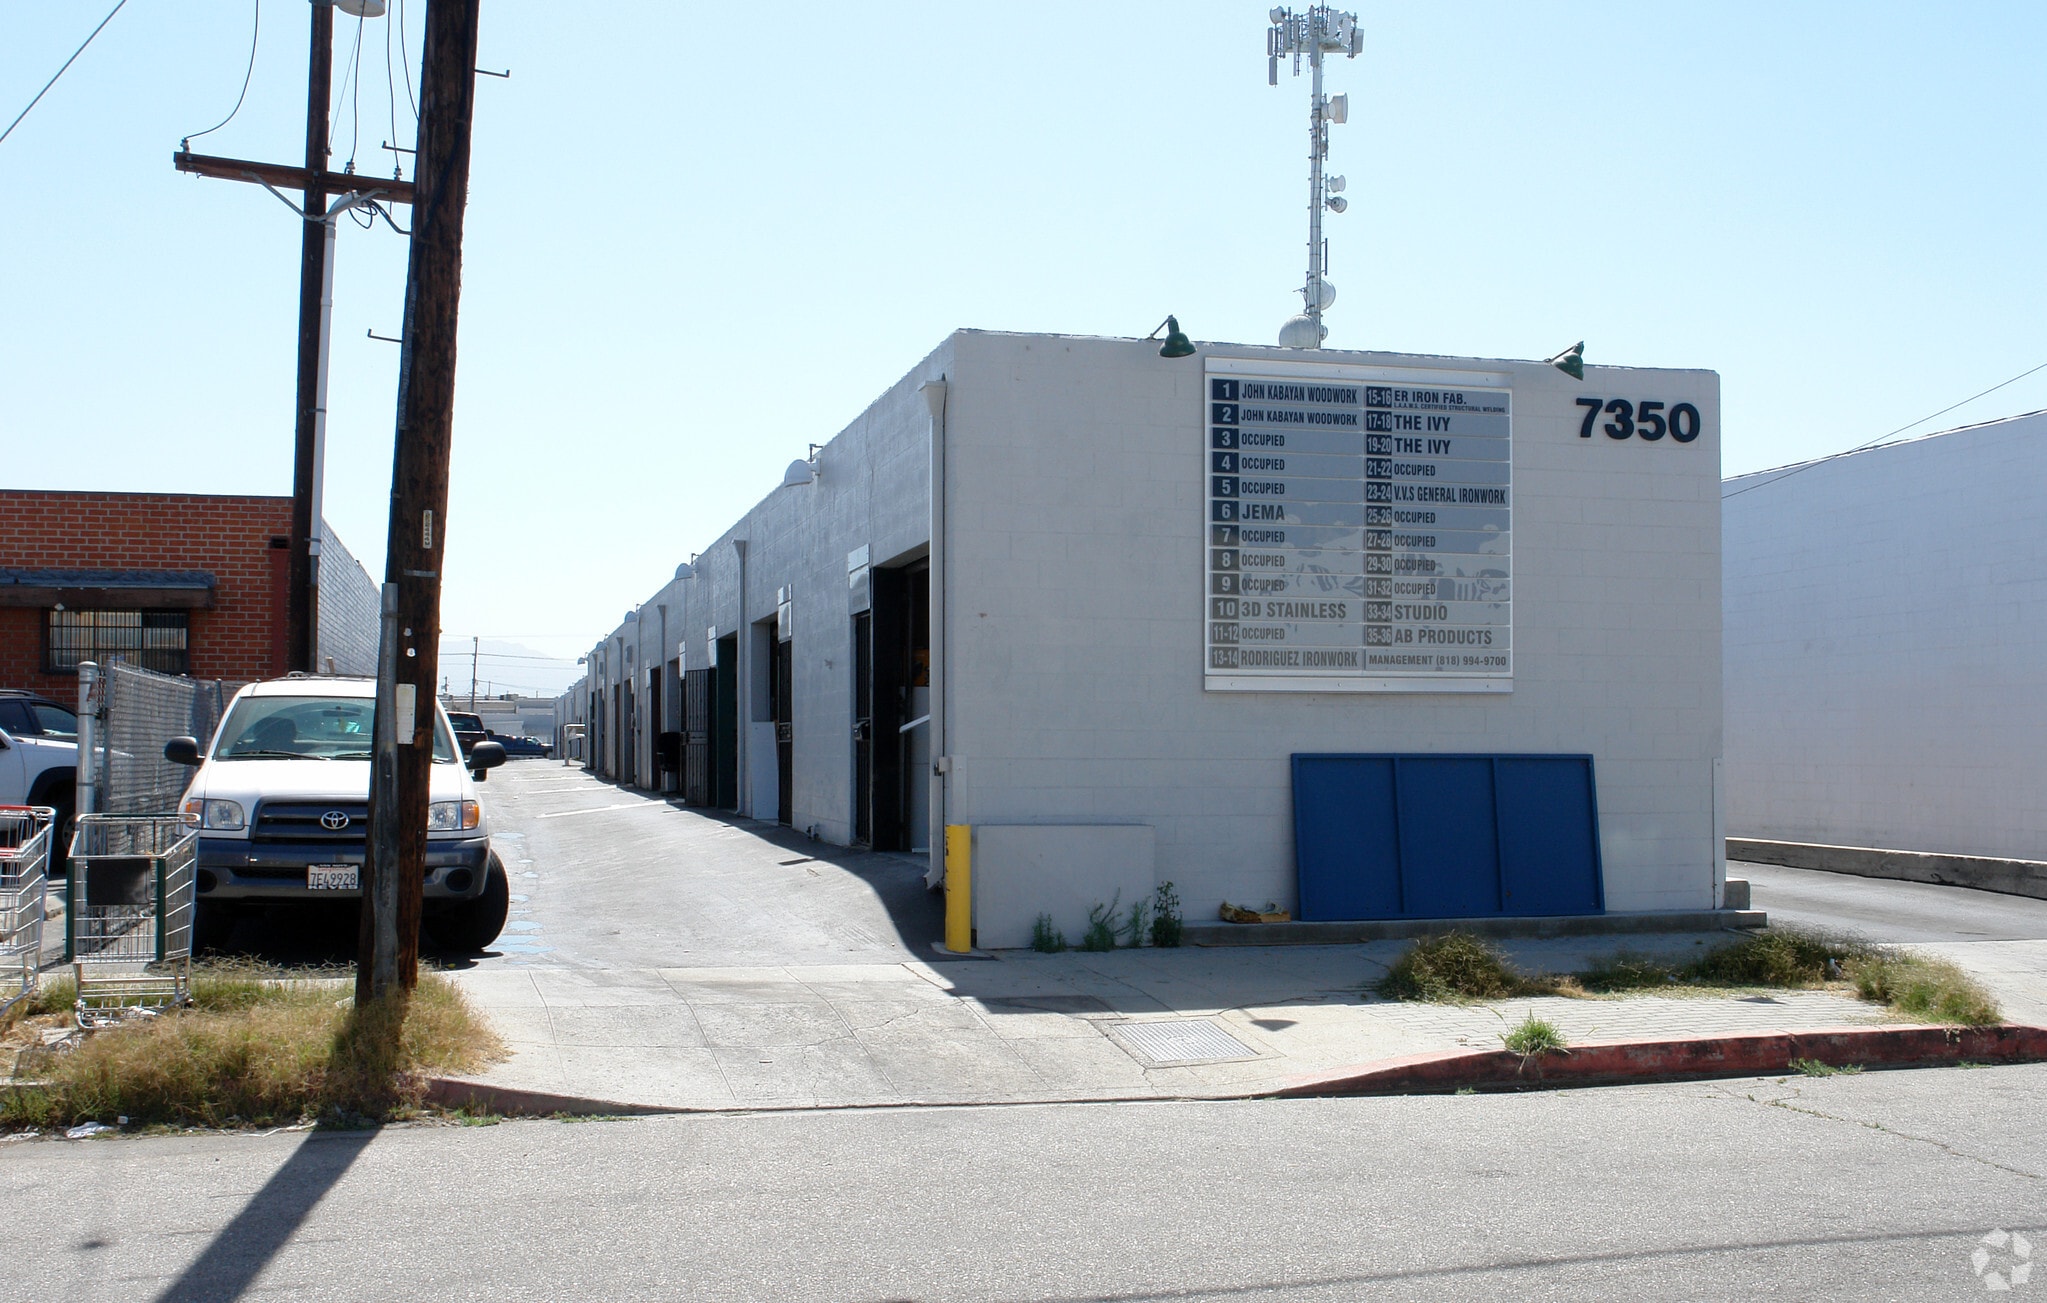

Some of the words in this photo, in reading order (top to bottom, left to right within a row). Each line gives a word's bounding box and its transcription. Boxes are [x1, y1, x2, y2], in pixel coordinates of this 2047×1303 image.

[1222, 382, 1230, 398] 1
[1242, 384, 1265, 399] JOHN
[1268, 385, 1305, 401] KABAYAN
[1307, 386, 1357, 404] WOODWORK
[1367, 389, 1392, 405] 15-16
[1394, 390, 1408, 402] ER
[1413, 391, 1439, 404] IRON
[1443, 392, 1467, 405] FAB.
[1448, 404, 1481, 412] STRUCTURAL
[1222, 407, 1231, 422] 2
[1241, 409, 1264, 422] JOHN
[1267, 411, 1304, 423] KABAYAN
[1307, 412, 1357, 426] WOODWORK
[1367, 414, 1392, 429] 17-18
[1394, 415, 1422, 430] THE
[1427, 416, 1451, 432] IVY
[1576, 397, 1700, 443] 7350
[1221, 431, 1231, 446] 3
[1241, 433, 1285, 447] OCCUPIED
[1367, 437, 1392, 452] 19-20
[1394, 438, 1422, 453] THE
[1428, 439, 1451, 454] IVY
[1221, 455, 1231, 470] 4
[1241, 457, 1285, 470] OCCUPIED
[1367, 461, 1392, 476] 21-22
[1394, 464, 1436, 476] OCCUPIED
[1221, 480, 1231, 494] 5
[1241, 482, 1285, 494] OCCUPIED
[1367, 485, 1392, 500] 23-24
[1394, 486, 1414, 501] V.V.S
[1418, 487, 1456, 503] GENERAL
[1459, 488, 1506, 504] IRONWORK
[1221, 503, 1231, 519] 6
[1242, 504, 1285, 521] JEMA
[1367, 508, 1392, 523] 25-26
[1394, 511, 1436, 524] OCCUPIED
[1221, 528, 1231, 542] 7
[1241, 530, 1285, 543] OCCUPIED
[1367, 533, 1392, 547] 27-28
[1394, 535, 1436, 547] OCCUPIED
[1221, 552, 1231, 567] 8
[1241, 554, 1285, 567] OCCUPIED
[1367, 556, 1392, 571] 29-30
[1394, 559, 1436, 571] OCCUPIED
[1221, 576, 1231, 591] 9
[1241, 578, 1285, 592] OCCUPIED
[1367, 580, 1392, 595] 31-32
[1394, 582, 1436, 595] OCCUPIED
[1217, 601, 1236, 616] 10
[1242, 602, 1261, 617] 3D
[1267, 602, 1347, 619] STAINLESS
[1367, 604, 1392, 619] 33-34
[1394, 605, 1448, 621] STUDIO
[1213, 625, 1239, 641] 11-12
[1241, 628, 1285, 640] OCCUPIED
[1367, 628, 1392, 643] 35-36
[1394, 629, 1413, 644] AB
[1418, 629, 1492, 645] PRODUCTS
[1212, 649, 1238, 665] 13-14
[1241, 649, 1300, 666] RODRIGUEZ
[1303, 650, 1358, 667] IRONWORK
[1369, 655, 1433, 666] MANAGEMENT
[1436, 655, 1460, 667] (818)
[1463, 656, 1507, 666] 994-9700
